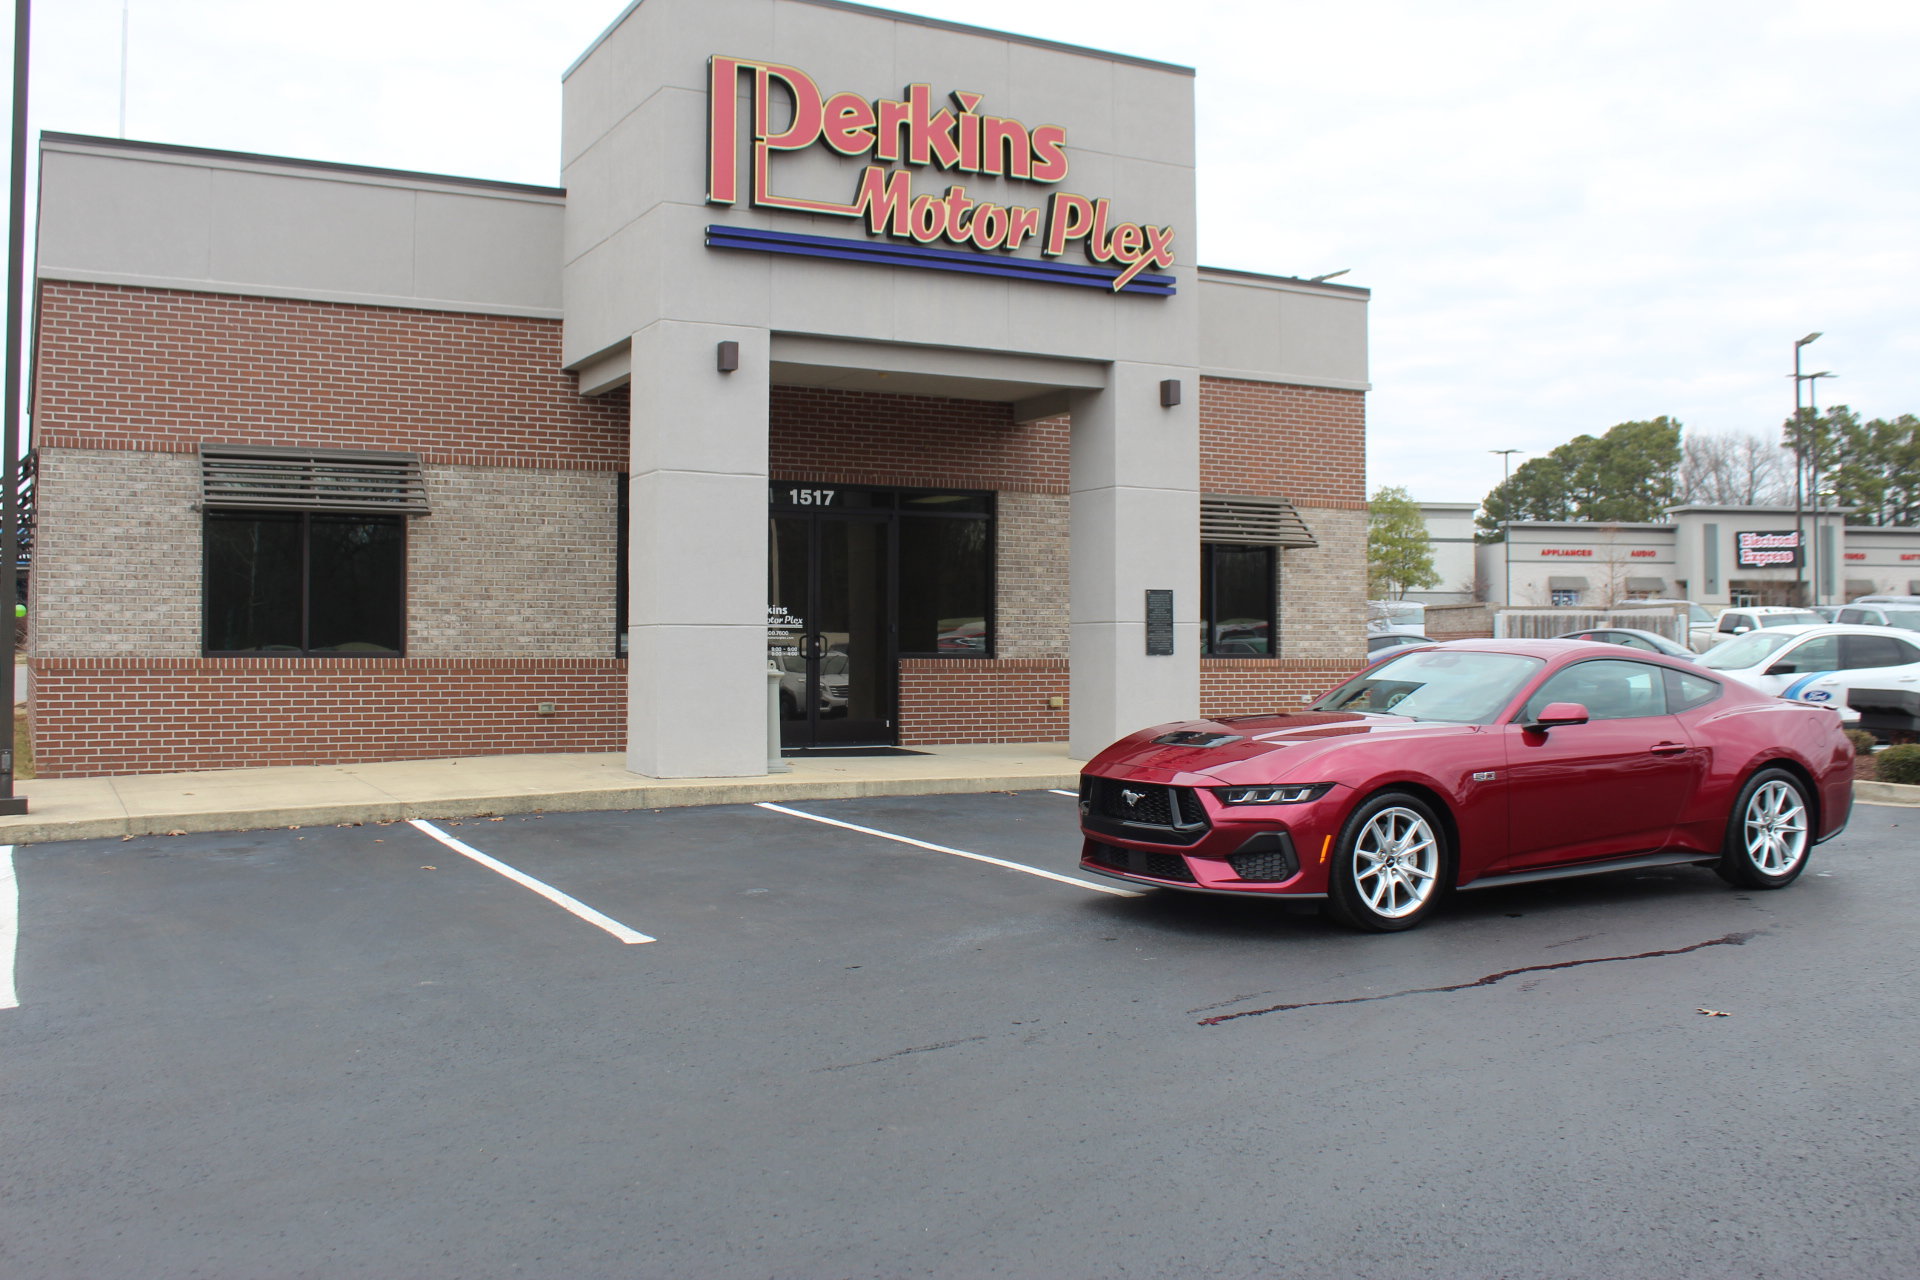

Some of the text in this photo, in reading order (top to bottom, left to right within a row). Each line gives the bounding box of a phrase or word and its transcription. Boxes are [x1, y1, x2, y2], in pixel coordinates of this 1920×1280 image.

[708, 55, 1068, 212] Perkins
[861, 166, 1175, 292] Motor Plex
[790, 489, 834, 505] 1517
[1739, 549, 1794, 567] Express
[767, 615, 803, 627] otor Plex
